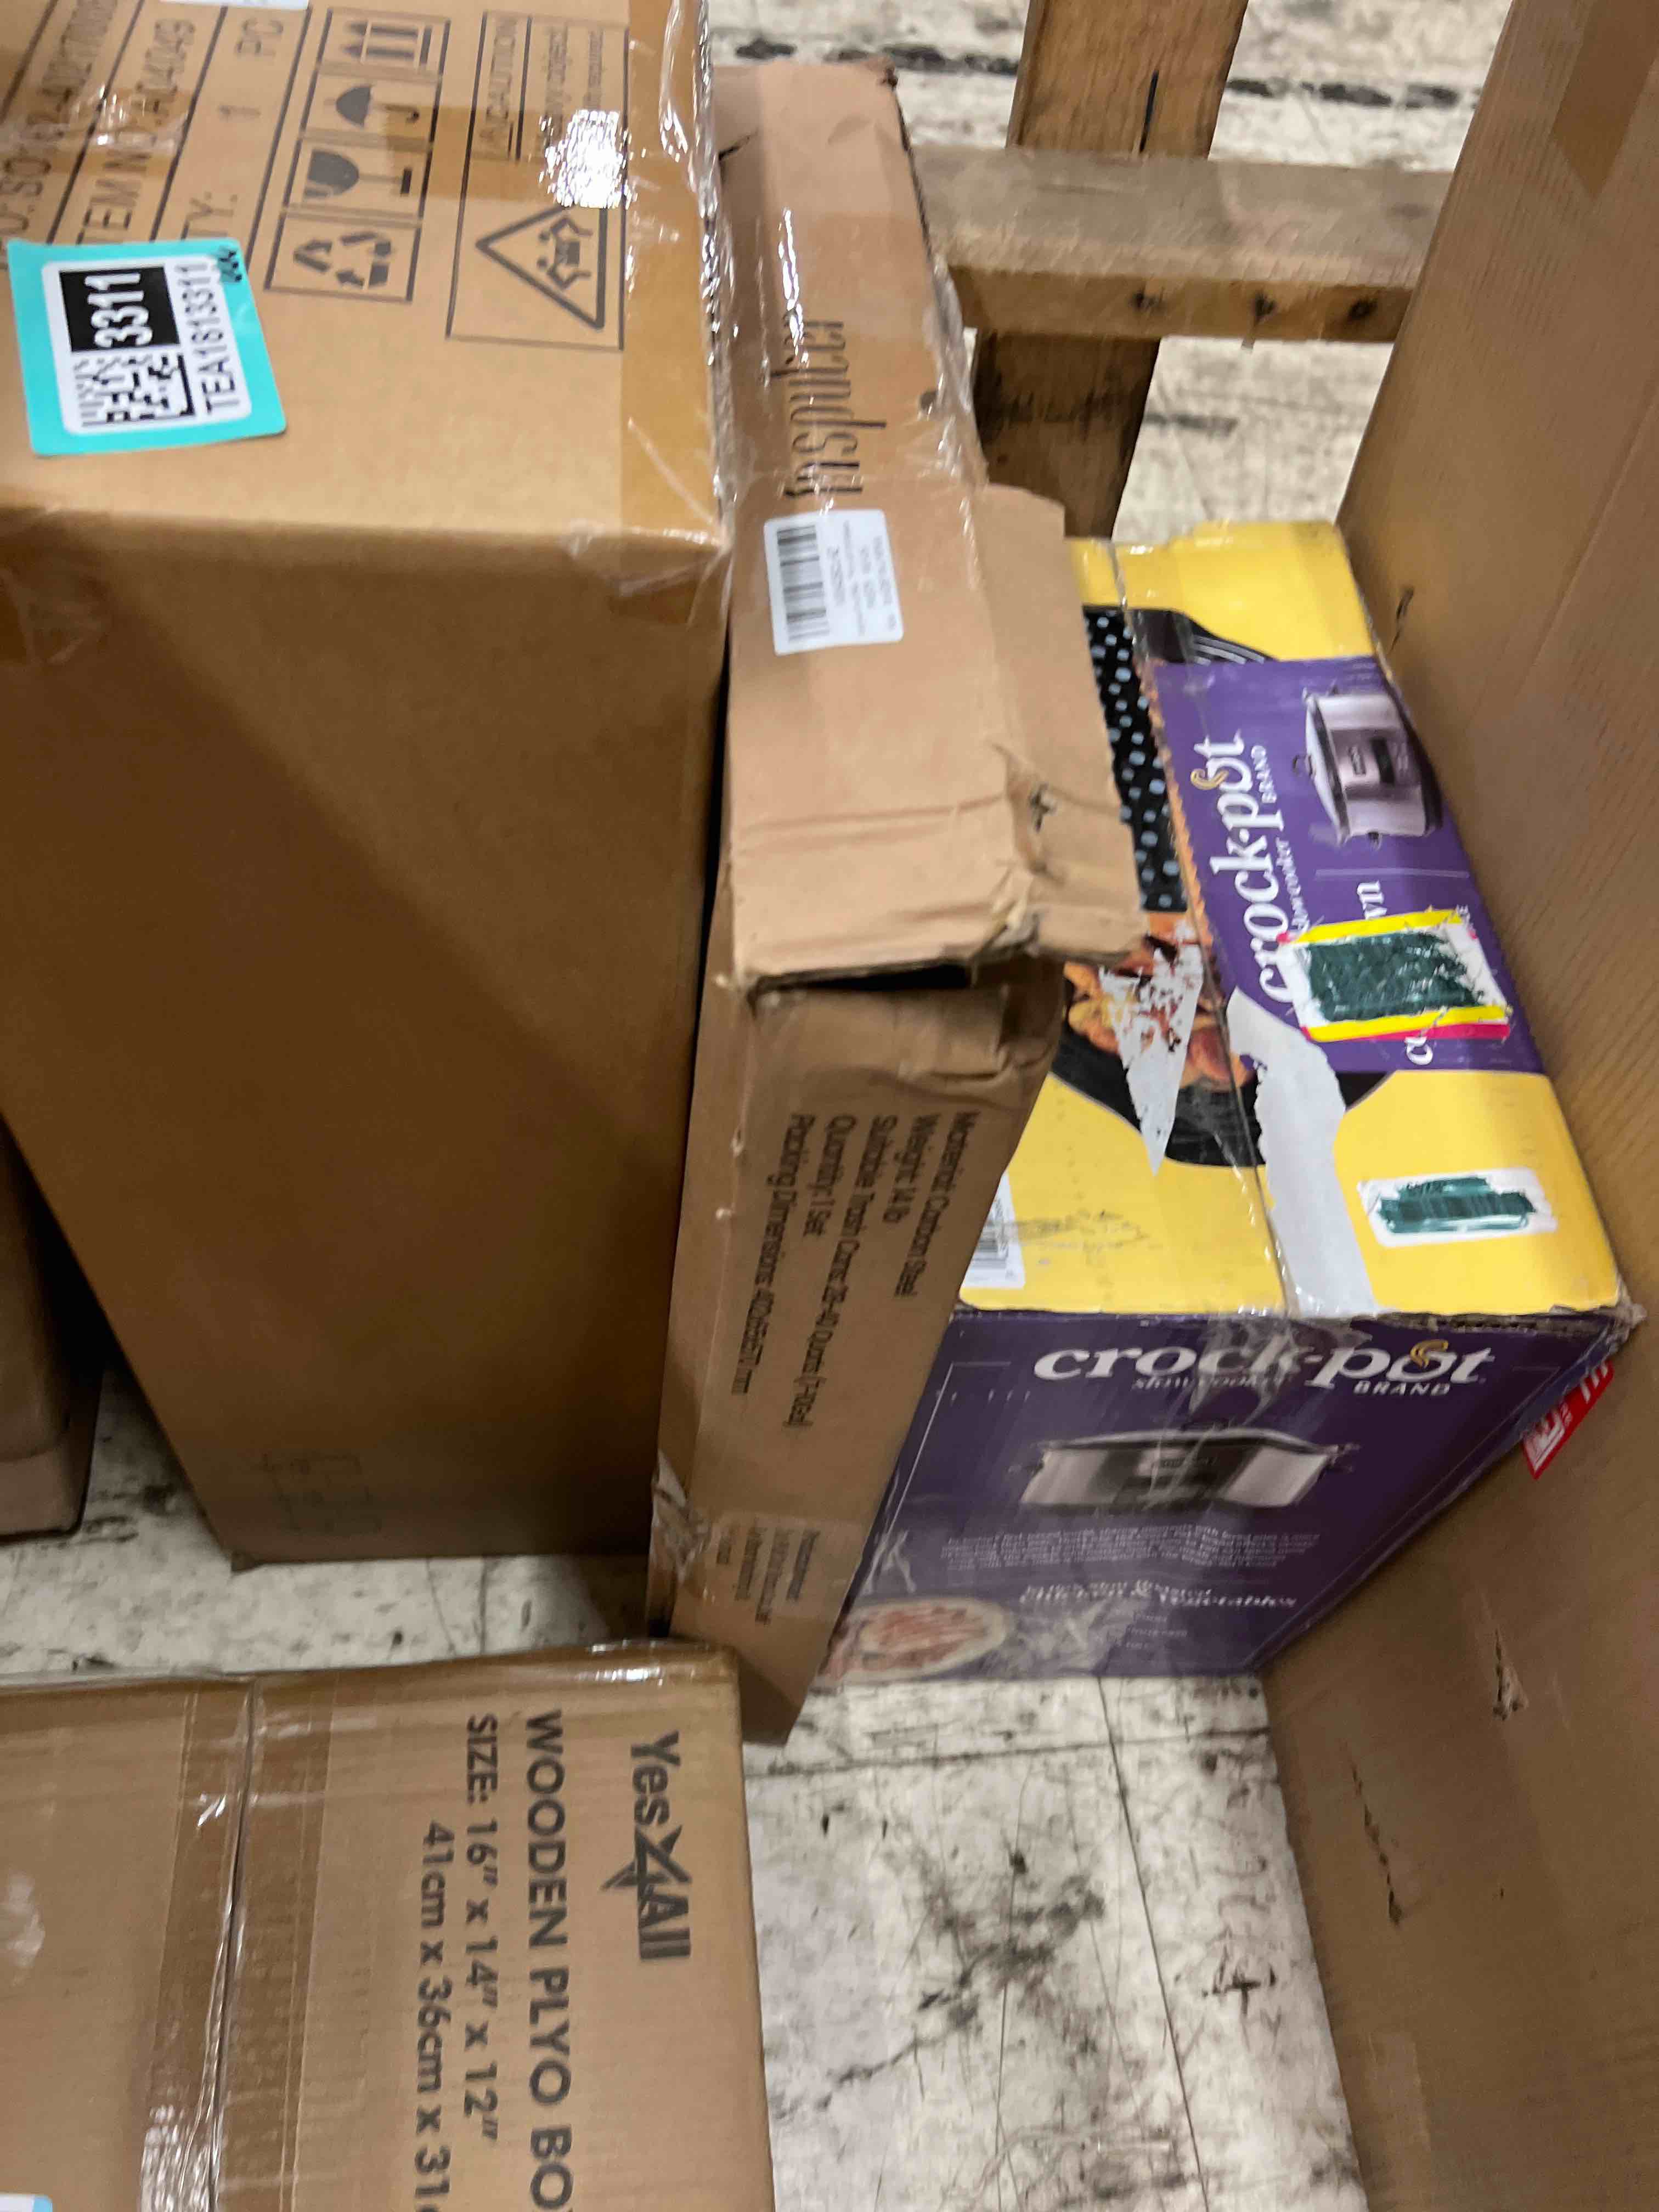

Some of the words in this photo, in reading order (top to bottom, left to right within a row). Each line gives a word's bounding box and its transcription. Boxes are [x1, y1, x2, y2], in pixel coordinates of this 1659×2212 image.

[83, 270, 162, 348] 3311
[176, 260, 241, 413] TEA1813311
[1250, 744, 1278, 803] BRAND
[1353, 1380, 1451, 1396] BRAND
[466, 1714, 498, 1804] SIZE:
[525, 1711, 568, 1947] WOODEN
[420, 1821, 455, 1926] 41cm
[465, 1898, 489, 1922] x
[419, 1941, 444, 1966] x
[415, 1976, 452, 2093] 36cm
[464, 2022, 490, 2052] x
[528, 1966, 572, 2104] PLYO
[415, 2106, 442, 2134] x
[415, 2144, 451, 2212] 31
[530, 2123, 574, 2212] BO
